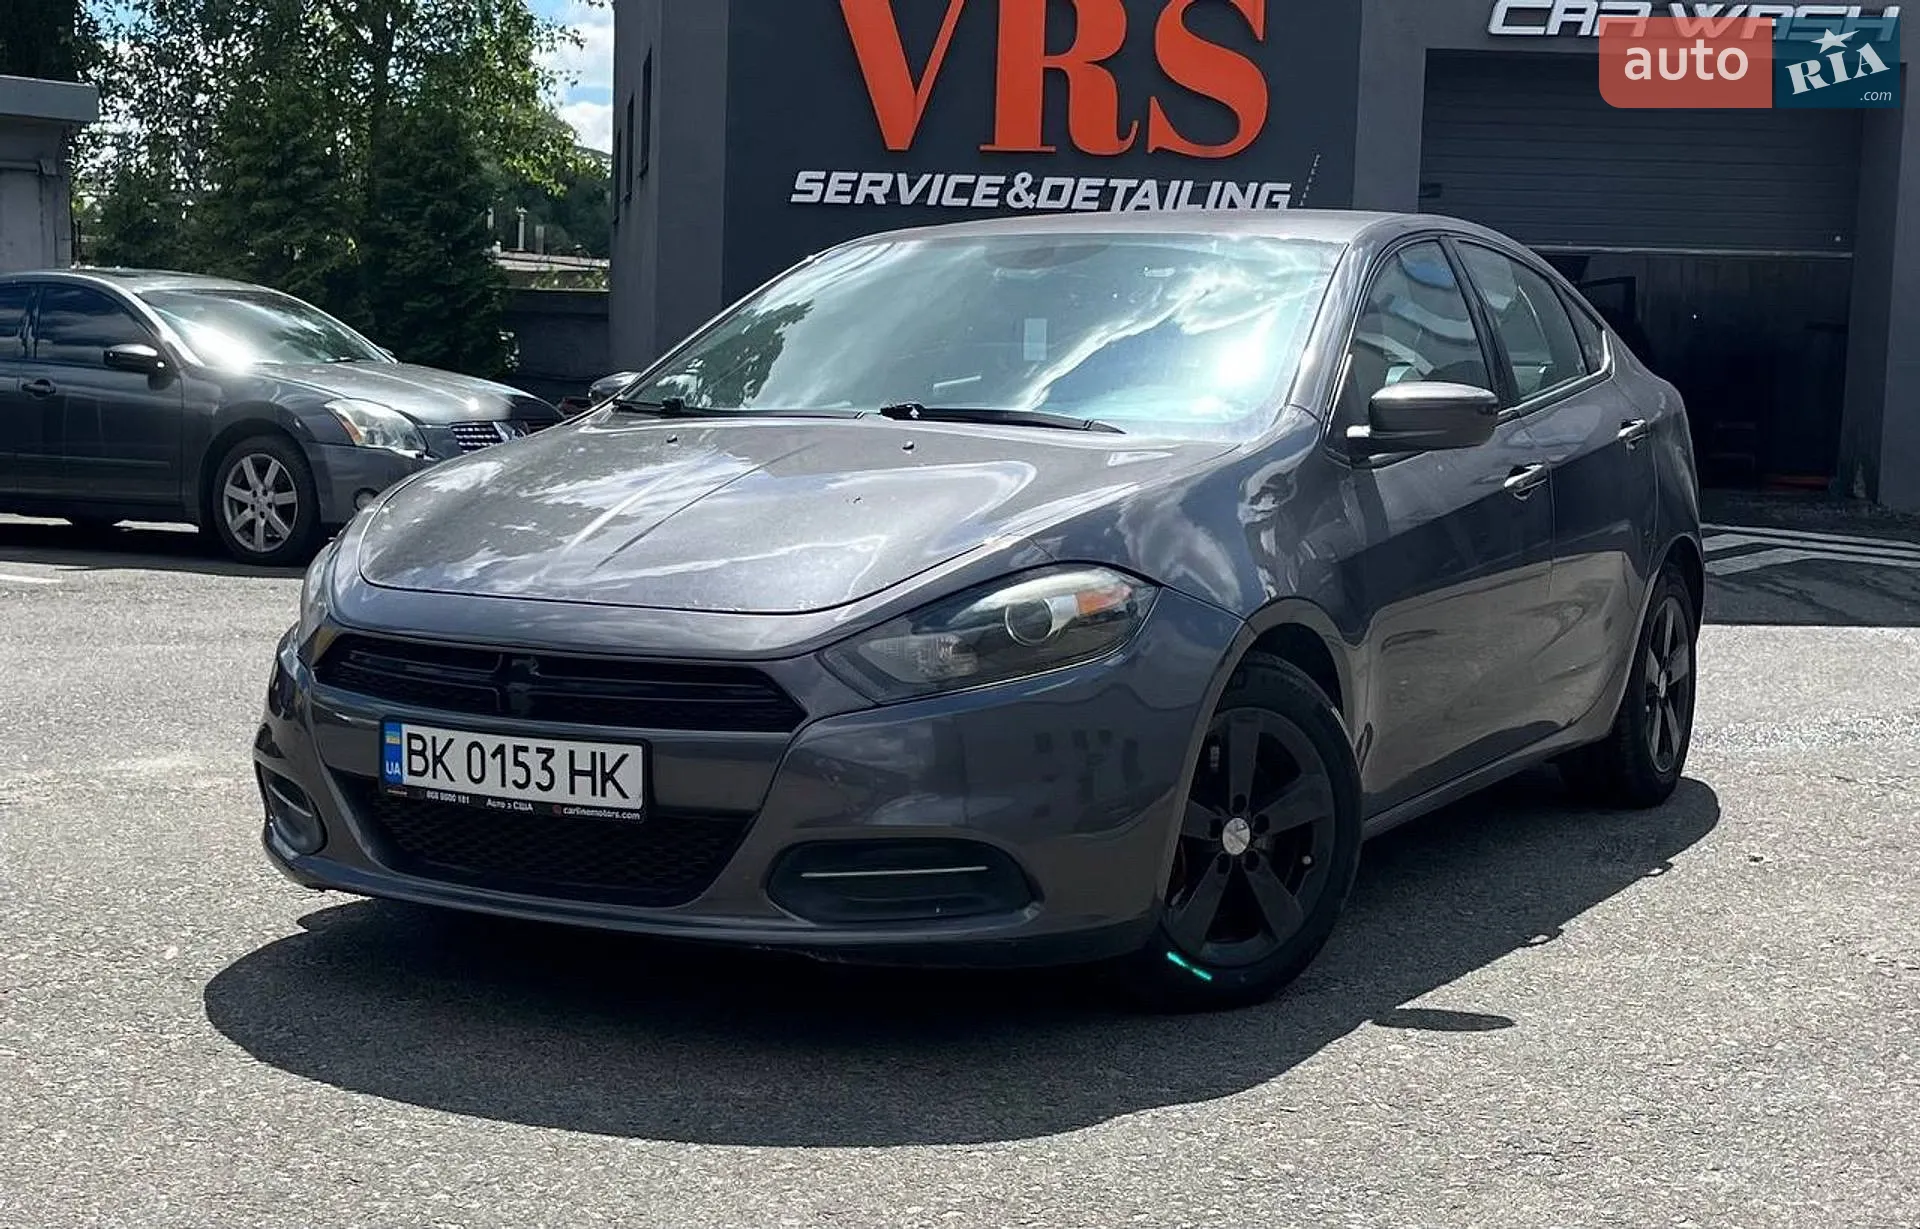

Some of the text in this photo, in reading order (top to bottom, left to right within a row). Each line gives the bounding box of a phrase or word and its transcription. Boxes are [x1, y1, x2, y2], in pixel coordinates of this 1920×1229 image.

[1488, 0, 1899, 42] CAR WASH
[839, 0, 1269, 158] VRS
[790, 171, 1291, 212] SERVICE&DETAILING
[385, 760, 401, 776] UA
[406, 731, 629, 800] BK 0153 HK
[563, 806, 641, 820] carlinemotors.com
